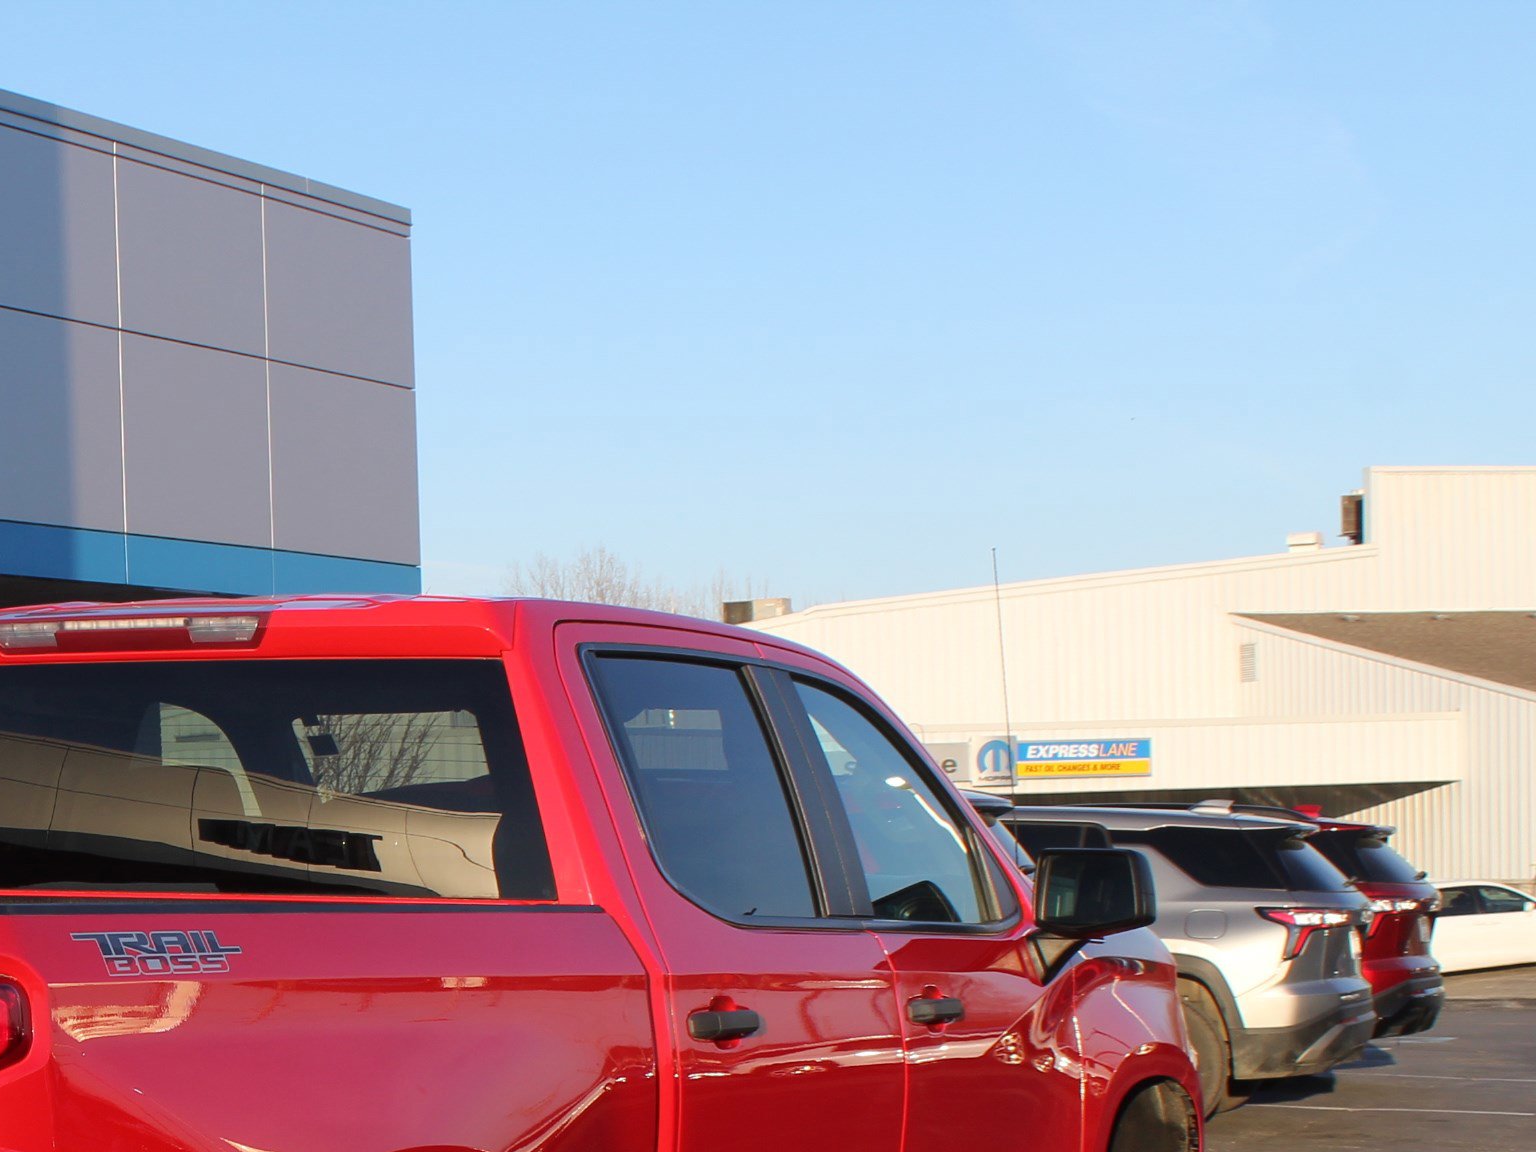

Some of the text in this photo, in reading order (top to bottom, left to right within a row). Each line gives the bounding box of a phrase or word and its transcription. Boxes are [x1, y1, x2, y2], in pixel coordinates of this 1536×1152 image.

[1025, 764, 1043, 773] FAST
[1044, 764, 1054, 773] OIL
[1057, 763, 1090, 773] CHANGES
[1099, 762, 1121, 772] MORE
[70, 931, 242, 956] TRAIL
[102, 953, 230, 976] BOSS
